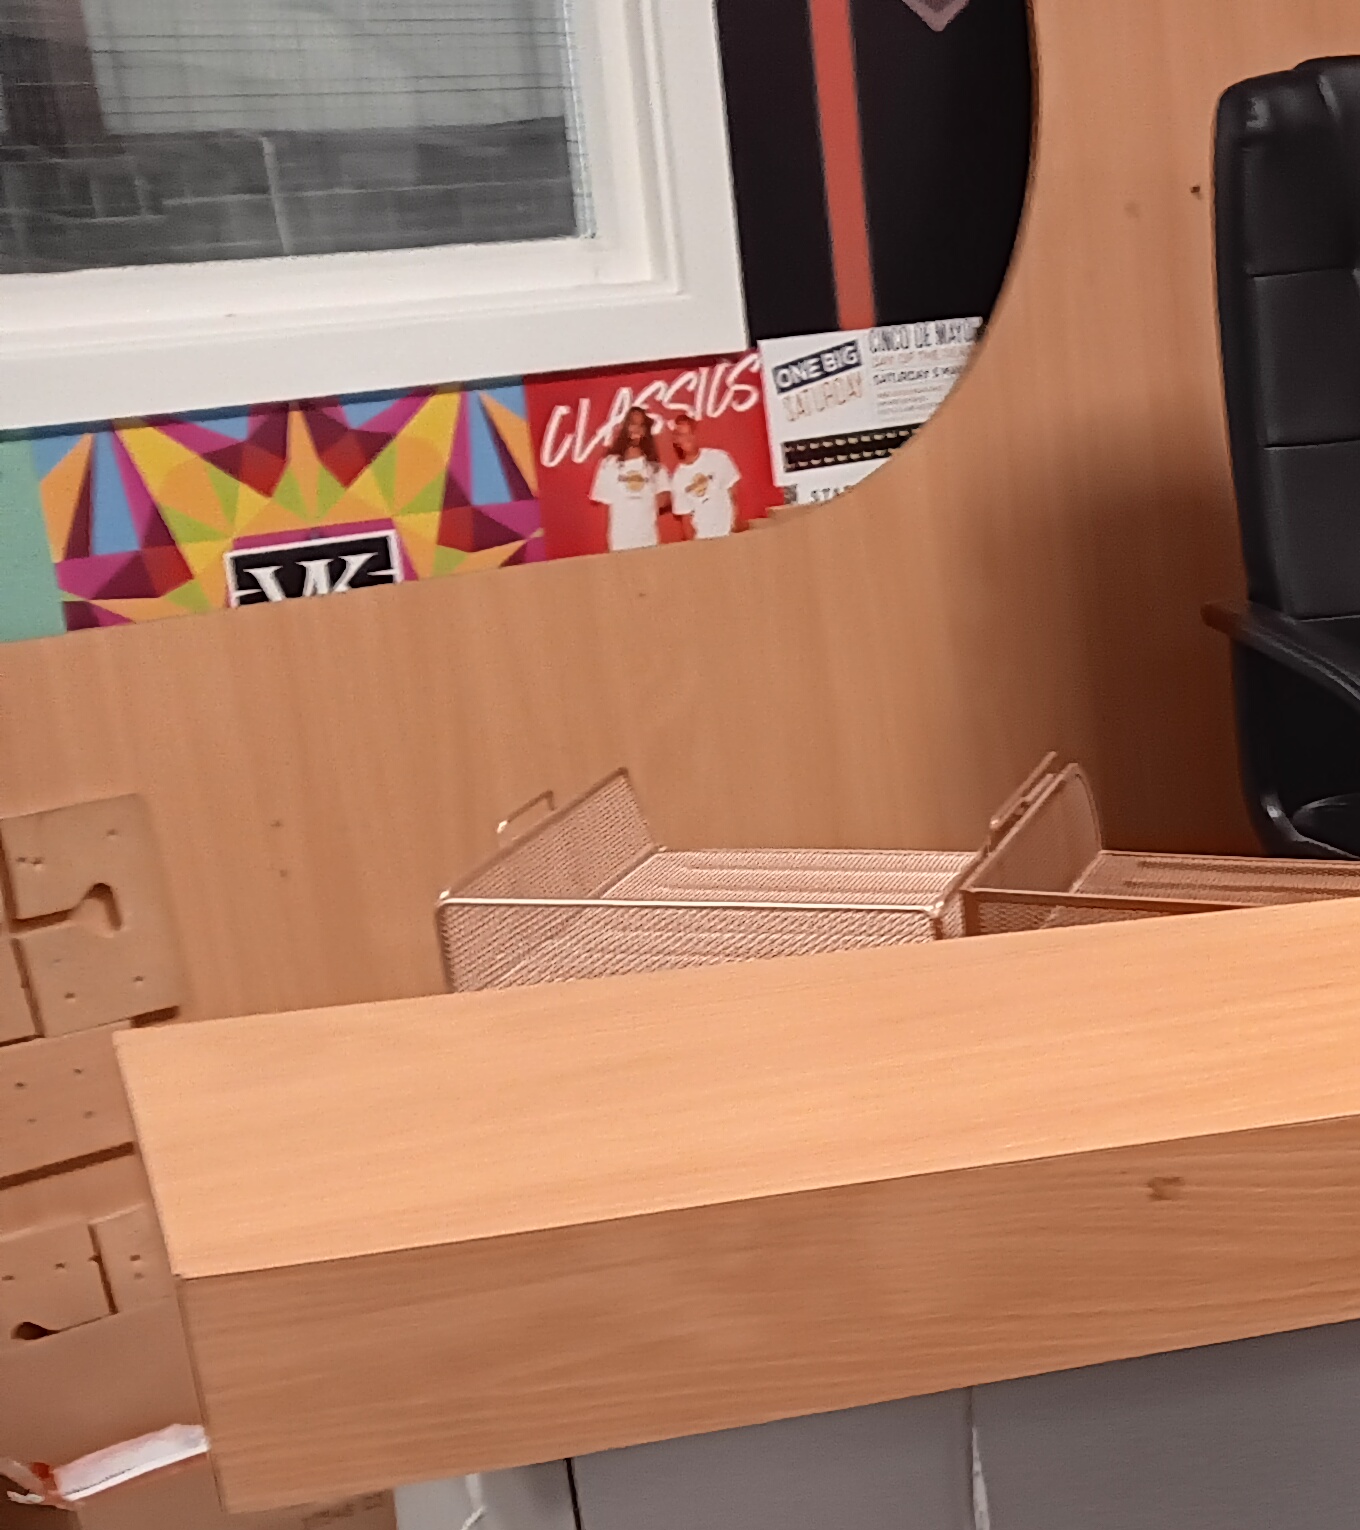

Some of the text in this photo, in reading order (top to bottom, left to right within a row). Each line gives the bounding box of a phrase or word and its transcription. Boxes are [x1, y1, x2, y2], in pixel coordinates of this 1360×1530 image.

[870, 325, 910, 352] CINCO
[915, 323, 931, 347] DE
[777, 357, 824, 388] ONE
[822, 345, 858, 371] BIG
[540, 353, 762, 468] CLASSICS
